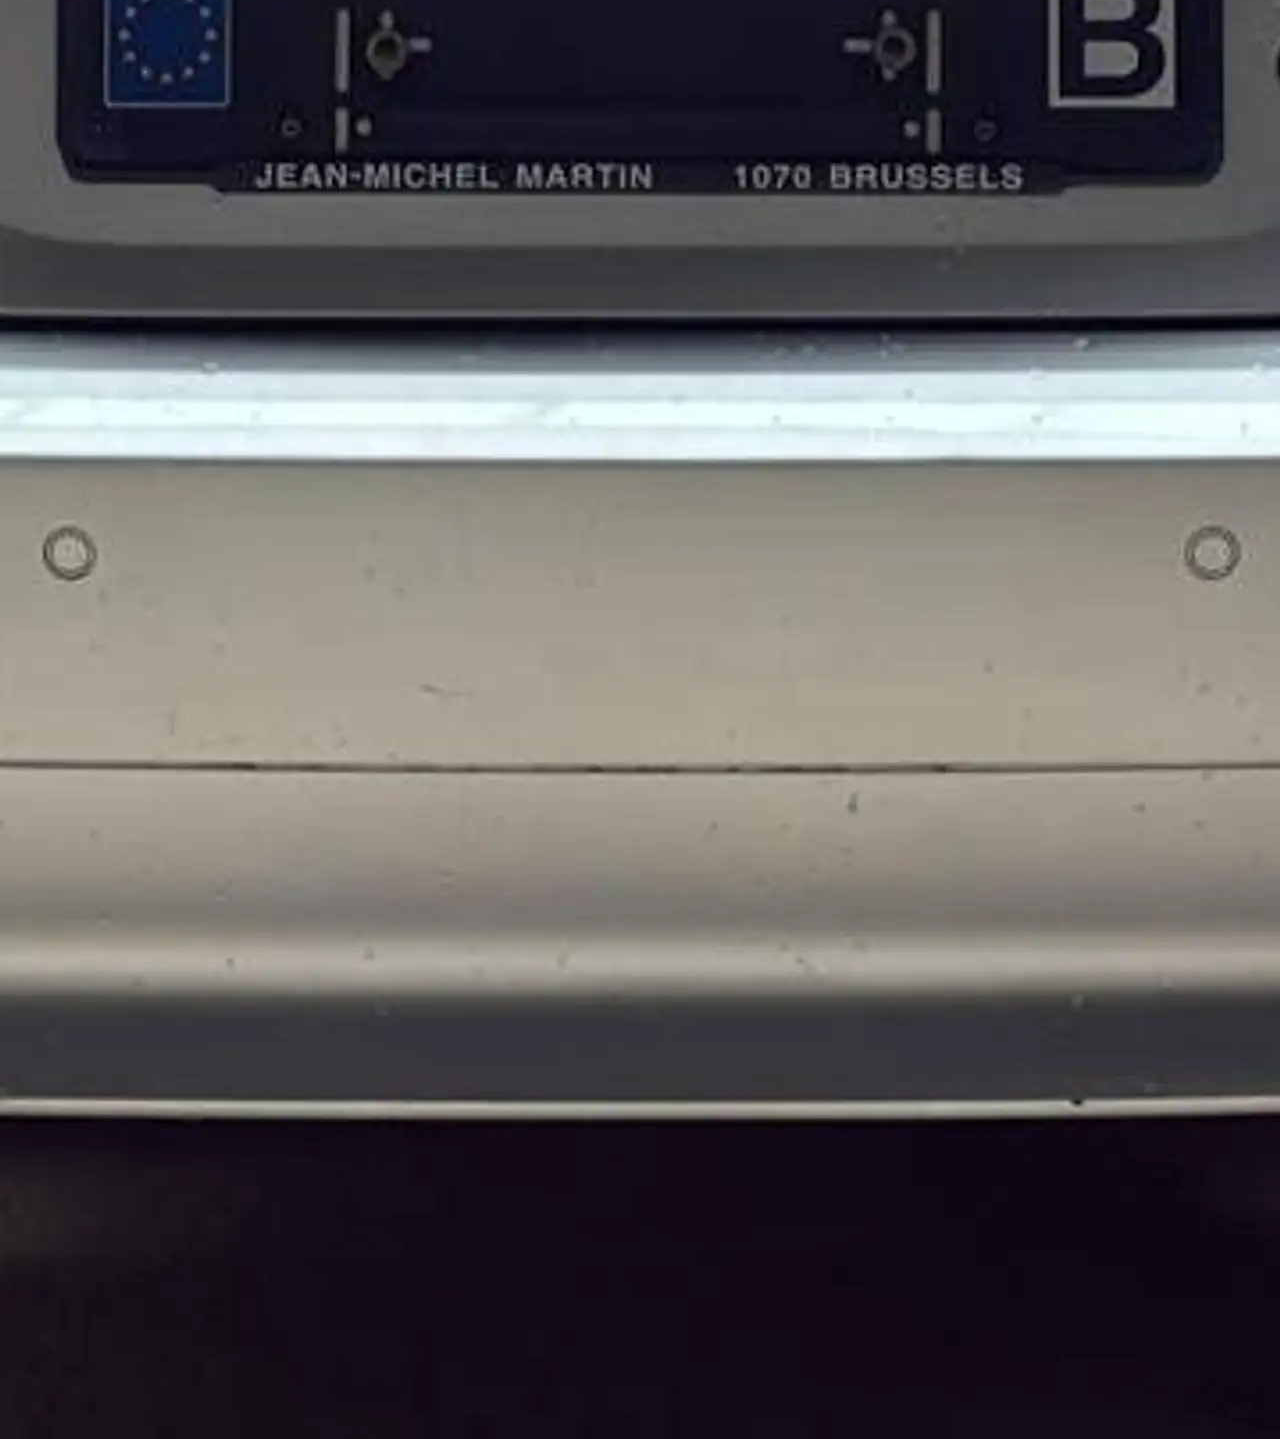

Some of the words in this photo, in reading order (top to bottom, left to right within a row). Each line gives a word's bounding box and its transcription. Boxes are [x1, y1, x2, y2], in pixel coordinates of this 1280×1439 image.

[255, 162, 499, 190] JEAN-MICHEL
[515, 162, 654, 190] MARTIN
[732, 163, 812, 190] 1070
[829, 163, 1025, 190] BRUSSELS
